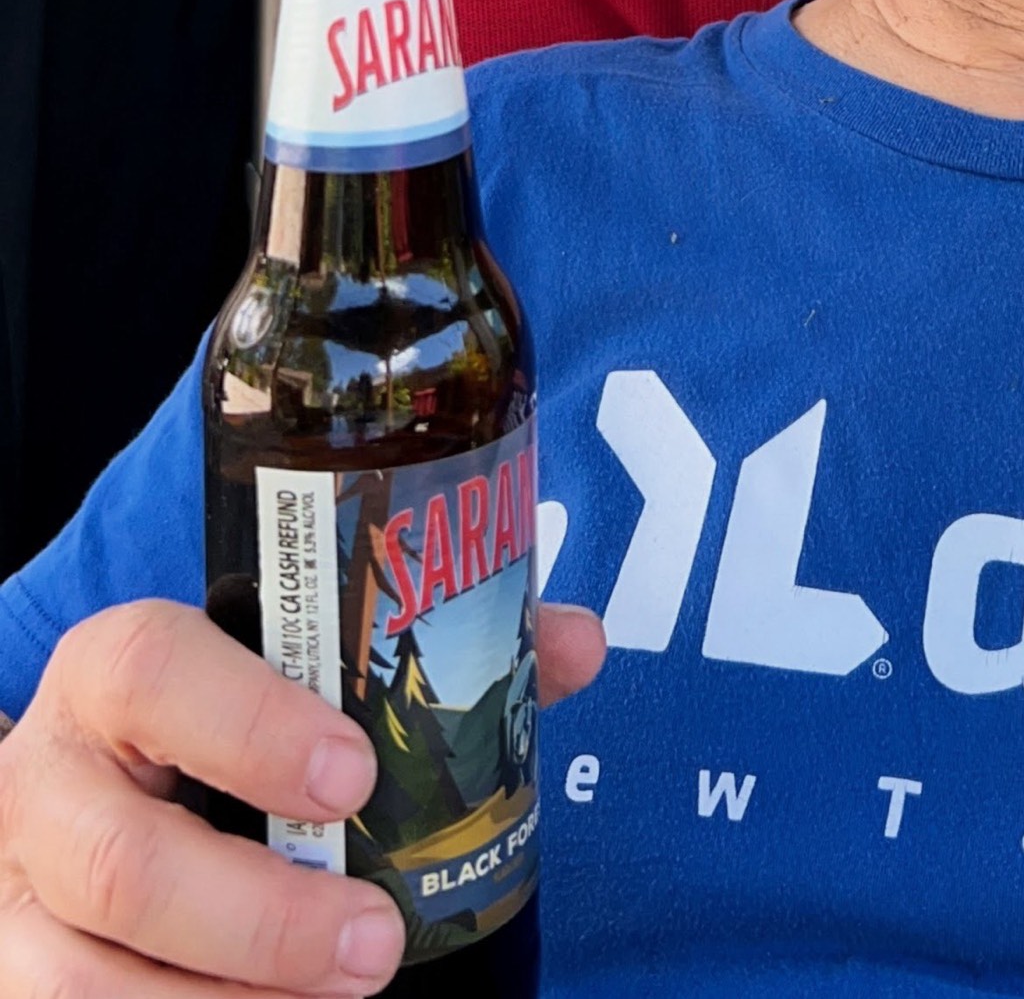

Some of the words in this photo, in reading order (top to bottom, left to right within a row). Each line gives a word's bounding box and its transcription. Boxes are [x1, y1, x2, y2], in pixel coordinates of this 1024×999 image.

[277, 490, 299, 550] REFUND
[279, 551, 301, 591] CASH
[280, 595, 301, 614] CA
[421, 844, 502, 897] BLACK
